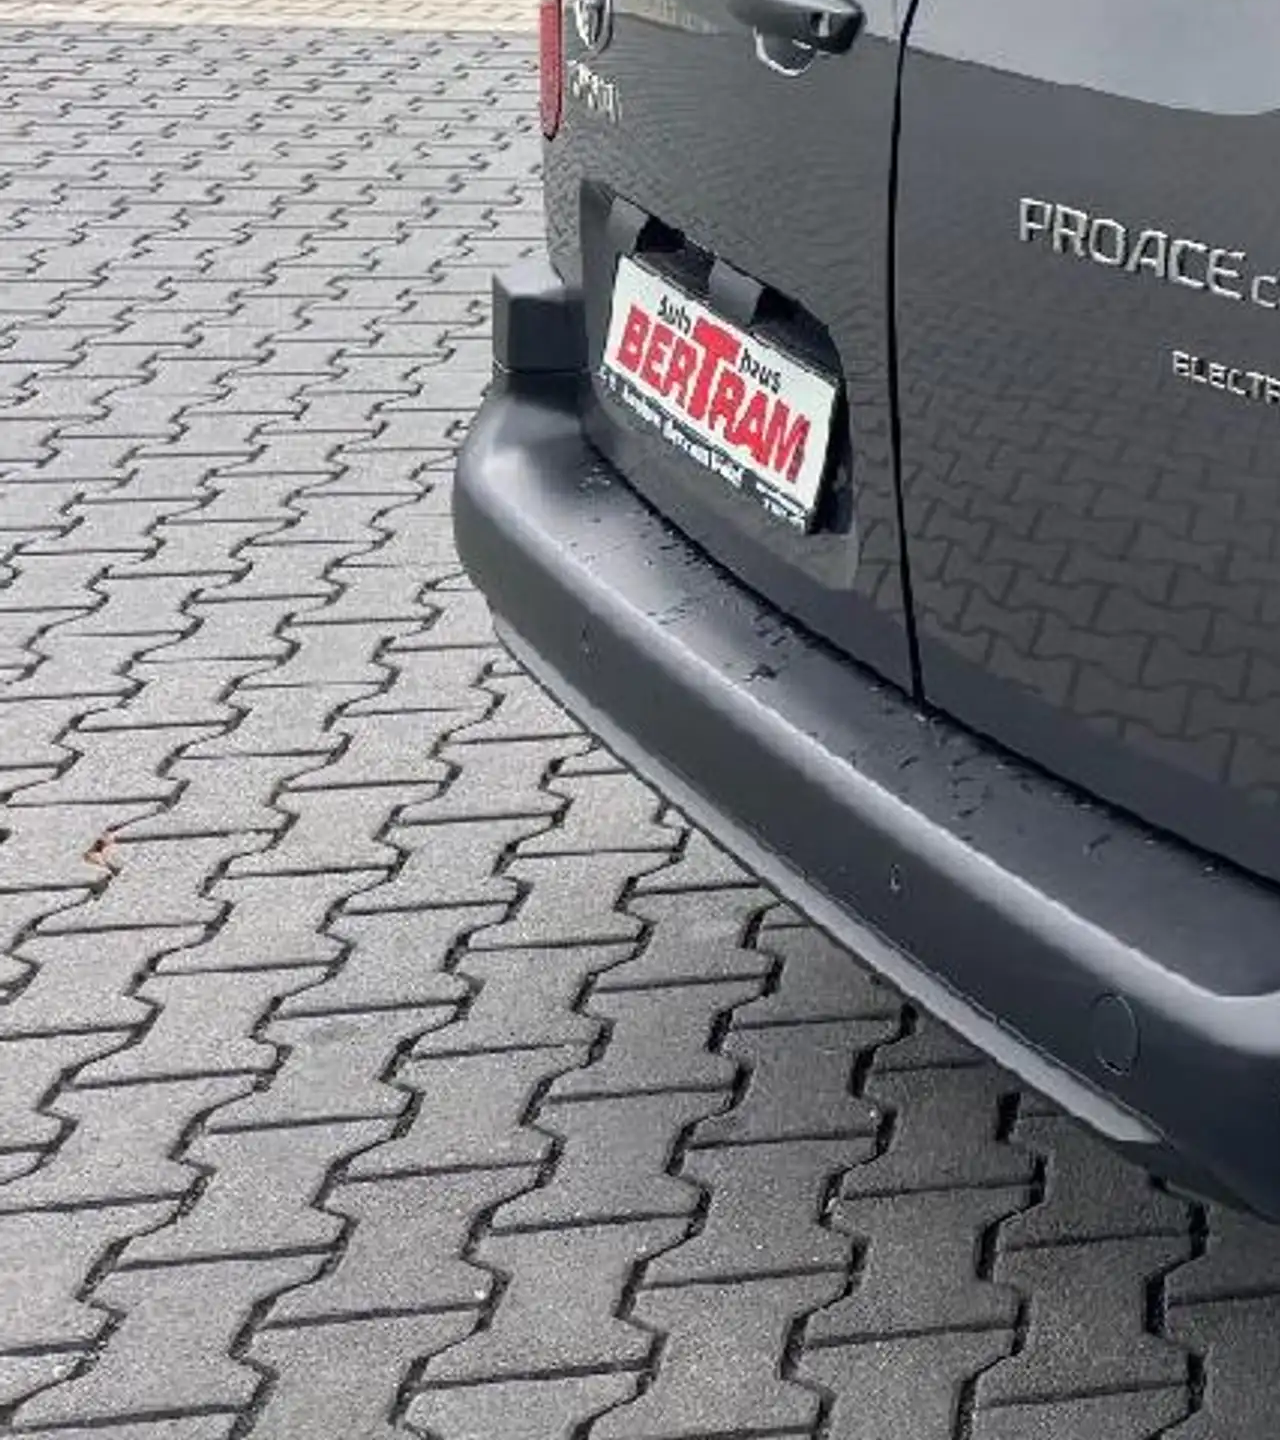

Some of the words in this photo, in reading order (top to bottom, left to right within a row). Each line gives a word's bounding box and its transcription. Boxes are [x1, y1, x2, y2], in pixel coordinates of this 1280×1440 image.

[1018, 197, 1247, 300] PROACE
[616, 303, 811, 485] BERTRAM
[740, 348, 784, 394] haus
